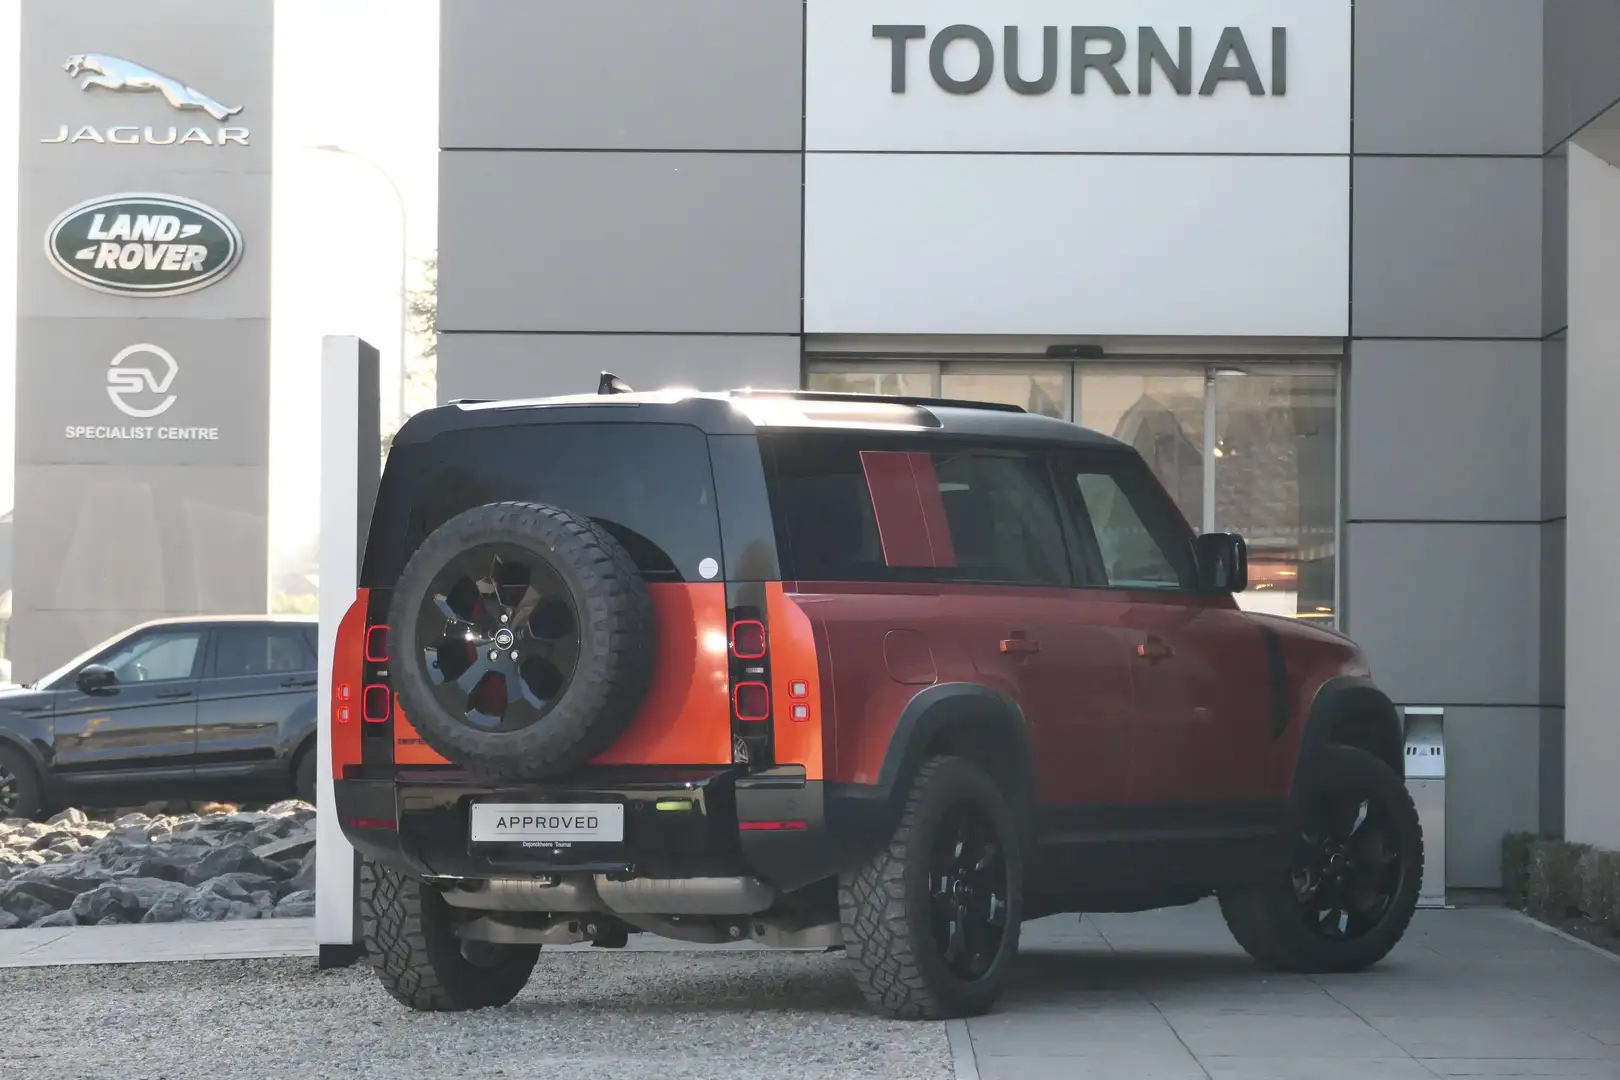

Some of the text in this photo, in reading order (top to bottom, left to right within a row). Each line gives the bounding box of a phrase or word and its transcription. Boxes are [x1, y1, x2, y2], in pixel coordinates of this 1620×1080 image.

[872, 24, 1287, 96] TOURNAI
[40, 124, 250, 146] JAGUAR
[87, 213, 181, 242] LAND
[94, 243, 208, 271] ROVER
[65, 425, 219, 440] SPECIALIST CENTRE
[496, 816, 599, 829] APPROVED
